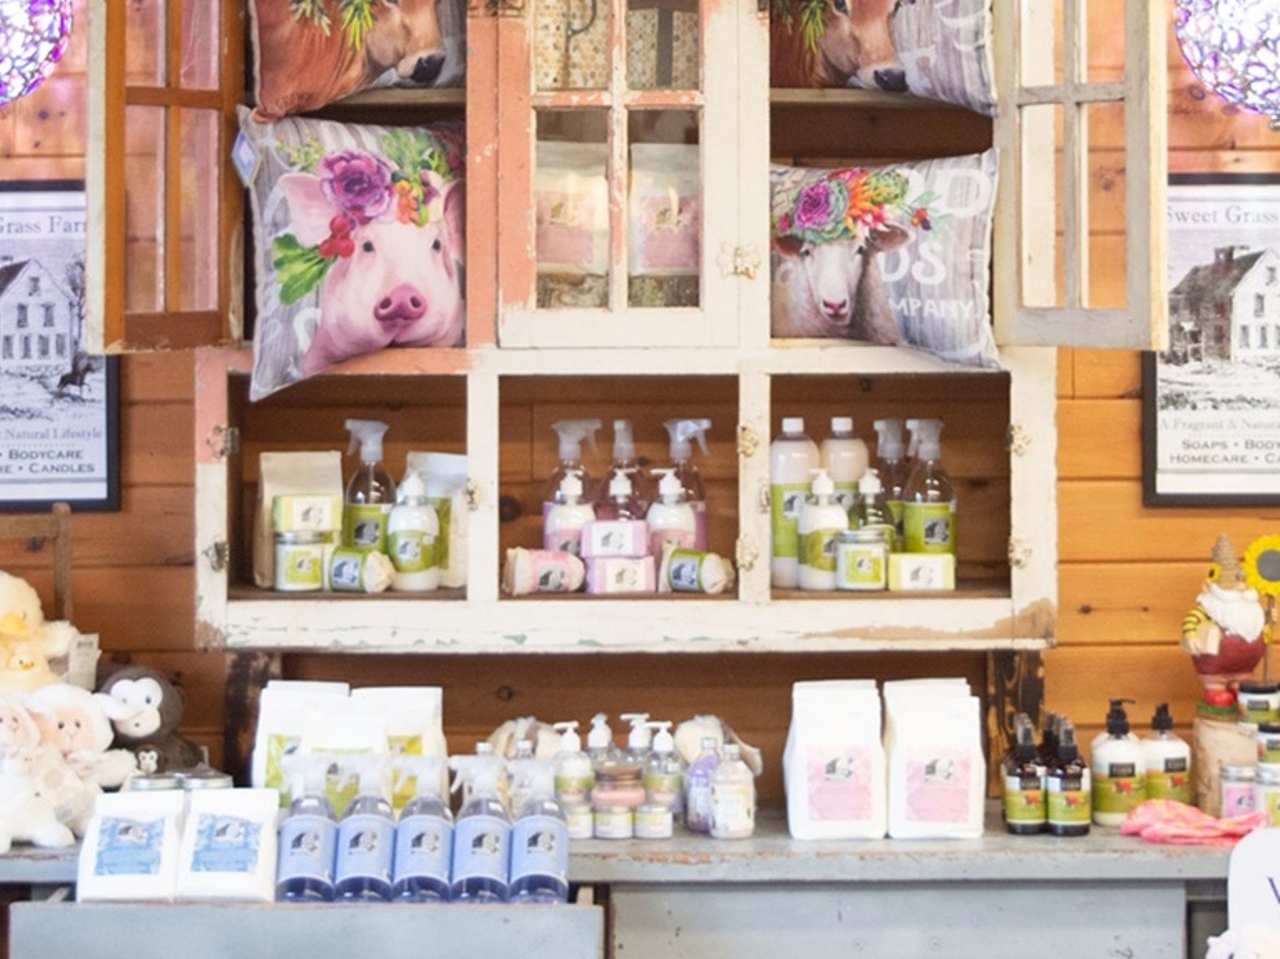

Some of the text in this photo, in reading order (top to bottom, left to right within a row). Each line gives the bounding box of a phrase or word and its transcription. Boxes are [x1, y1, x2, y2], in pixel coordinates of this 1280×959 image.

[1225, 204, 1279, 225] Grass
[1172, 417, 1225, 433] Fragrant
[5, 427, 50, 441] Natural
[52, 427, 103, 442] Lifestyle
[1181, 439, 1228, 450] SOAPS
[8, 448, 84, 461] BODYCARE
[1169, 453, 1249, 465] HOMECARE
[28, 462, 96, 474] CANDLES
